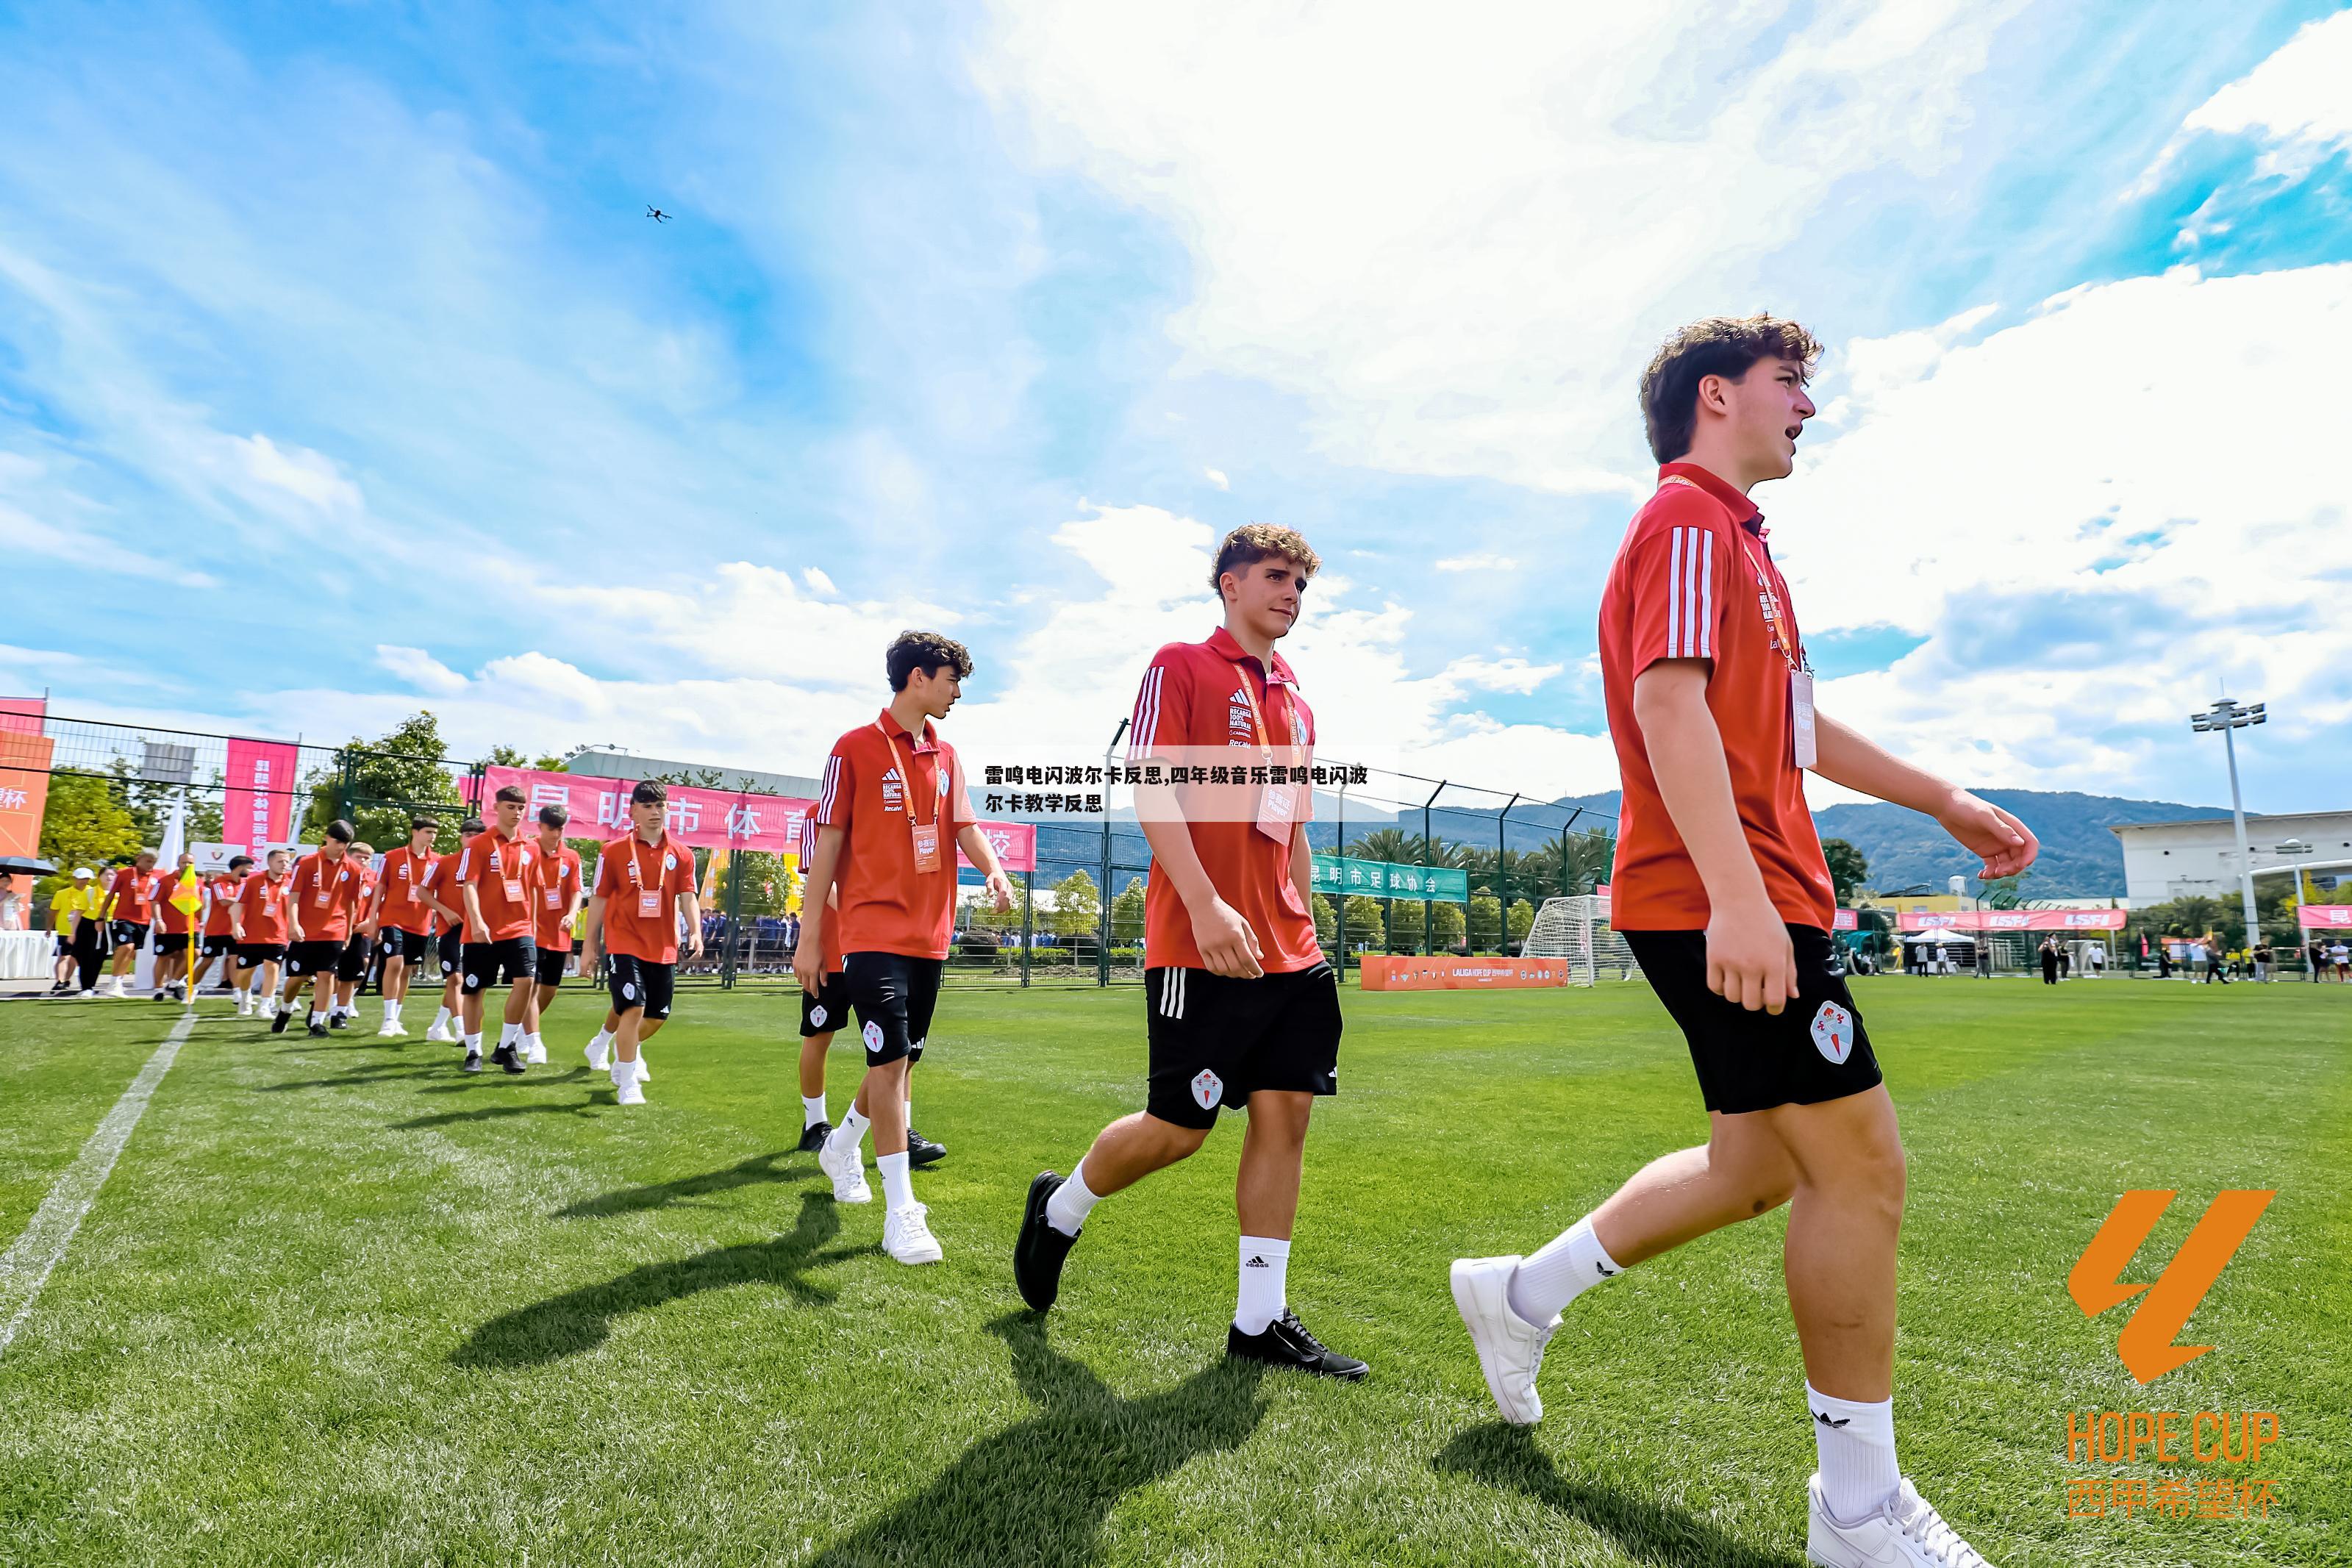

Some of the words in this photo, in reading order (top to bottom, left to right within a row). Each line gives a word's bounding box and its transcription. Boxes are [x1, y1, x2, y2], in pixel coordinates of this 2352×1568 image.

[1229, 708, 1251, 719] RECARGA
[1230, 714, 1244, 722] 100%
[1229, 720, 1251, 730] NATURAL
[1267, 798, 1288, 817] Player
[1312, 864, 1436, 893] 昆明市足球协会
[1453, 969, 1472, 977] LALIGA
